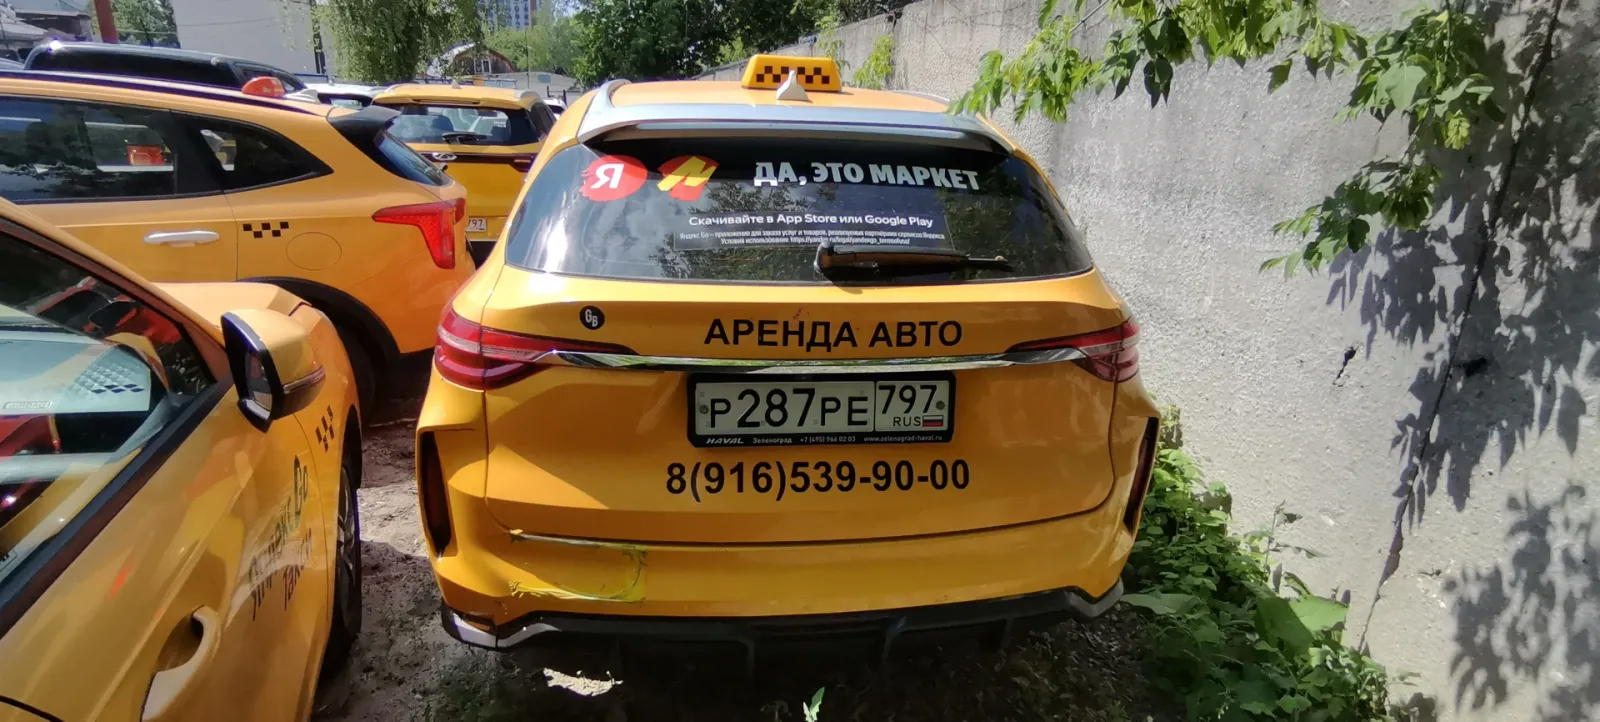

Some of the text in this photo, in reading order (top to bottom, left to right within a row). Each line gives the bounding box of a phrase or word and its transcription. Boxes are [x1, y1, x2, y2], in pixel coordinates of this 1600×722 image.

[754, 162, 980, 190] ДА, ЭТО МАРКЕТ
[689, 214, 934, 228] Скачивайте в App Store или Google Play
[703, 318, 962, 352] АРЕНДА АВТО
[878, 384, 937, 414] 797
[893, 416, 921, 427] RUS
[706, 437, 744, 445] HAVAL
[753, 437, 793, 445] Зеленоград
[809, 436, 825, 444] (495)
[666, 458, 970, 502] 8(916)539-90-00
